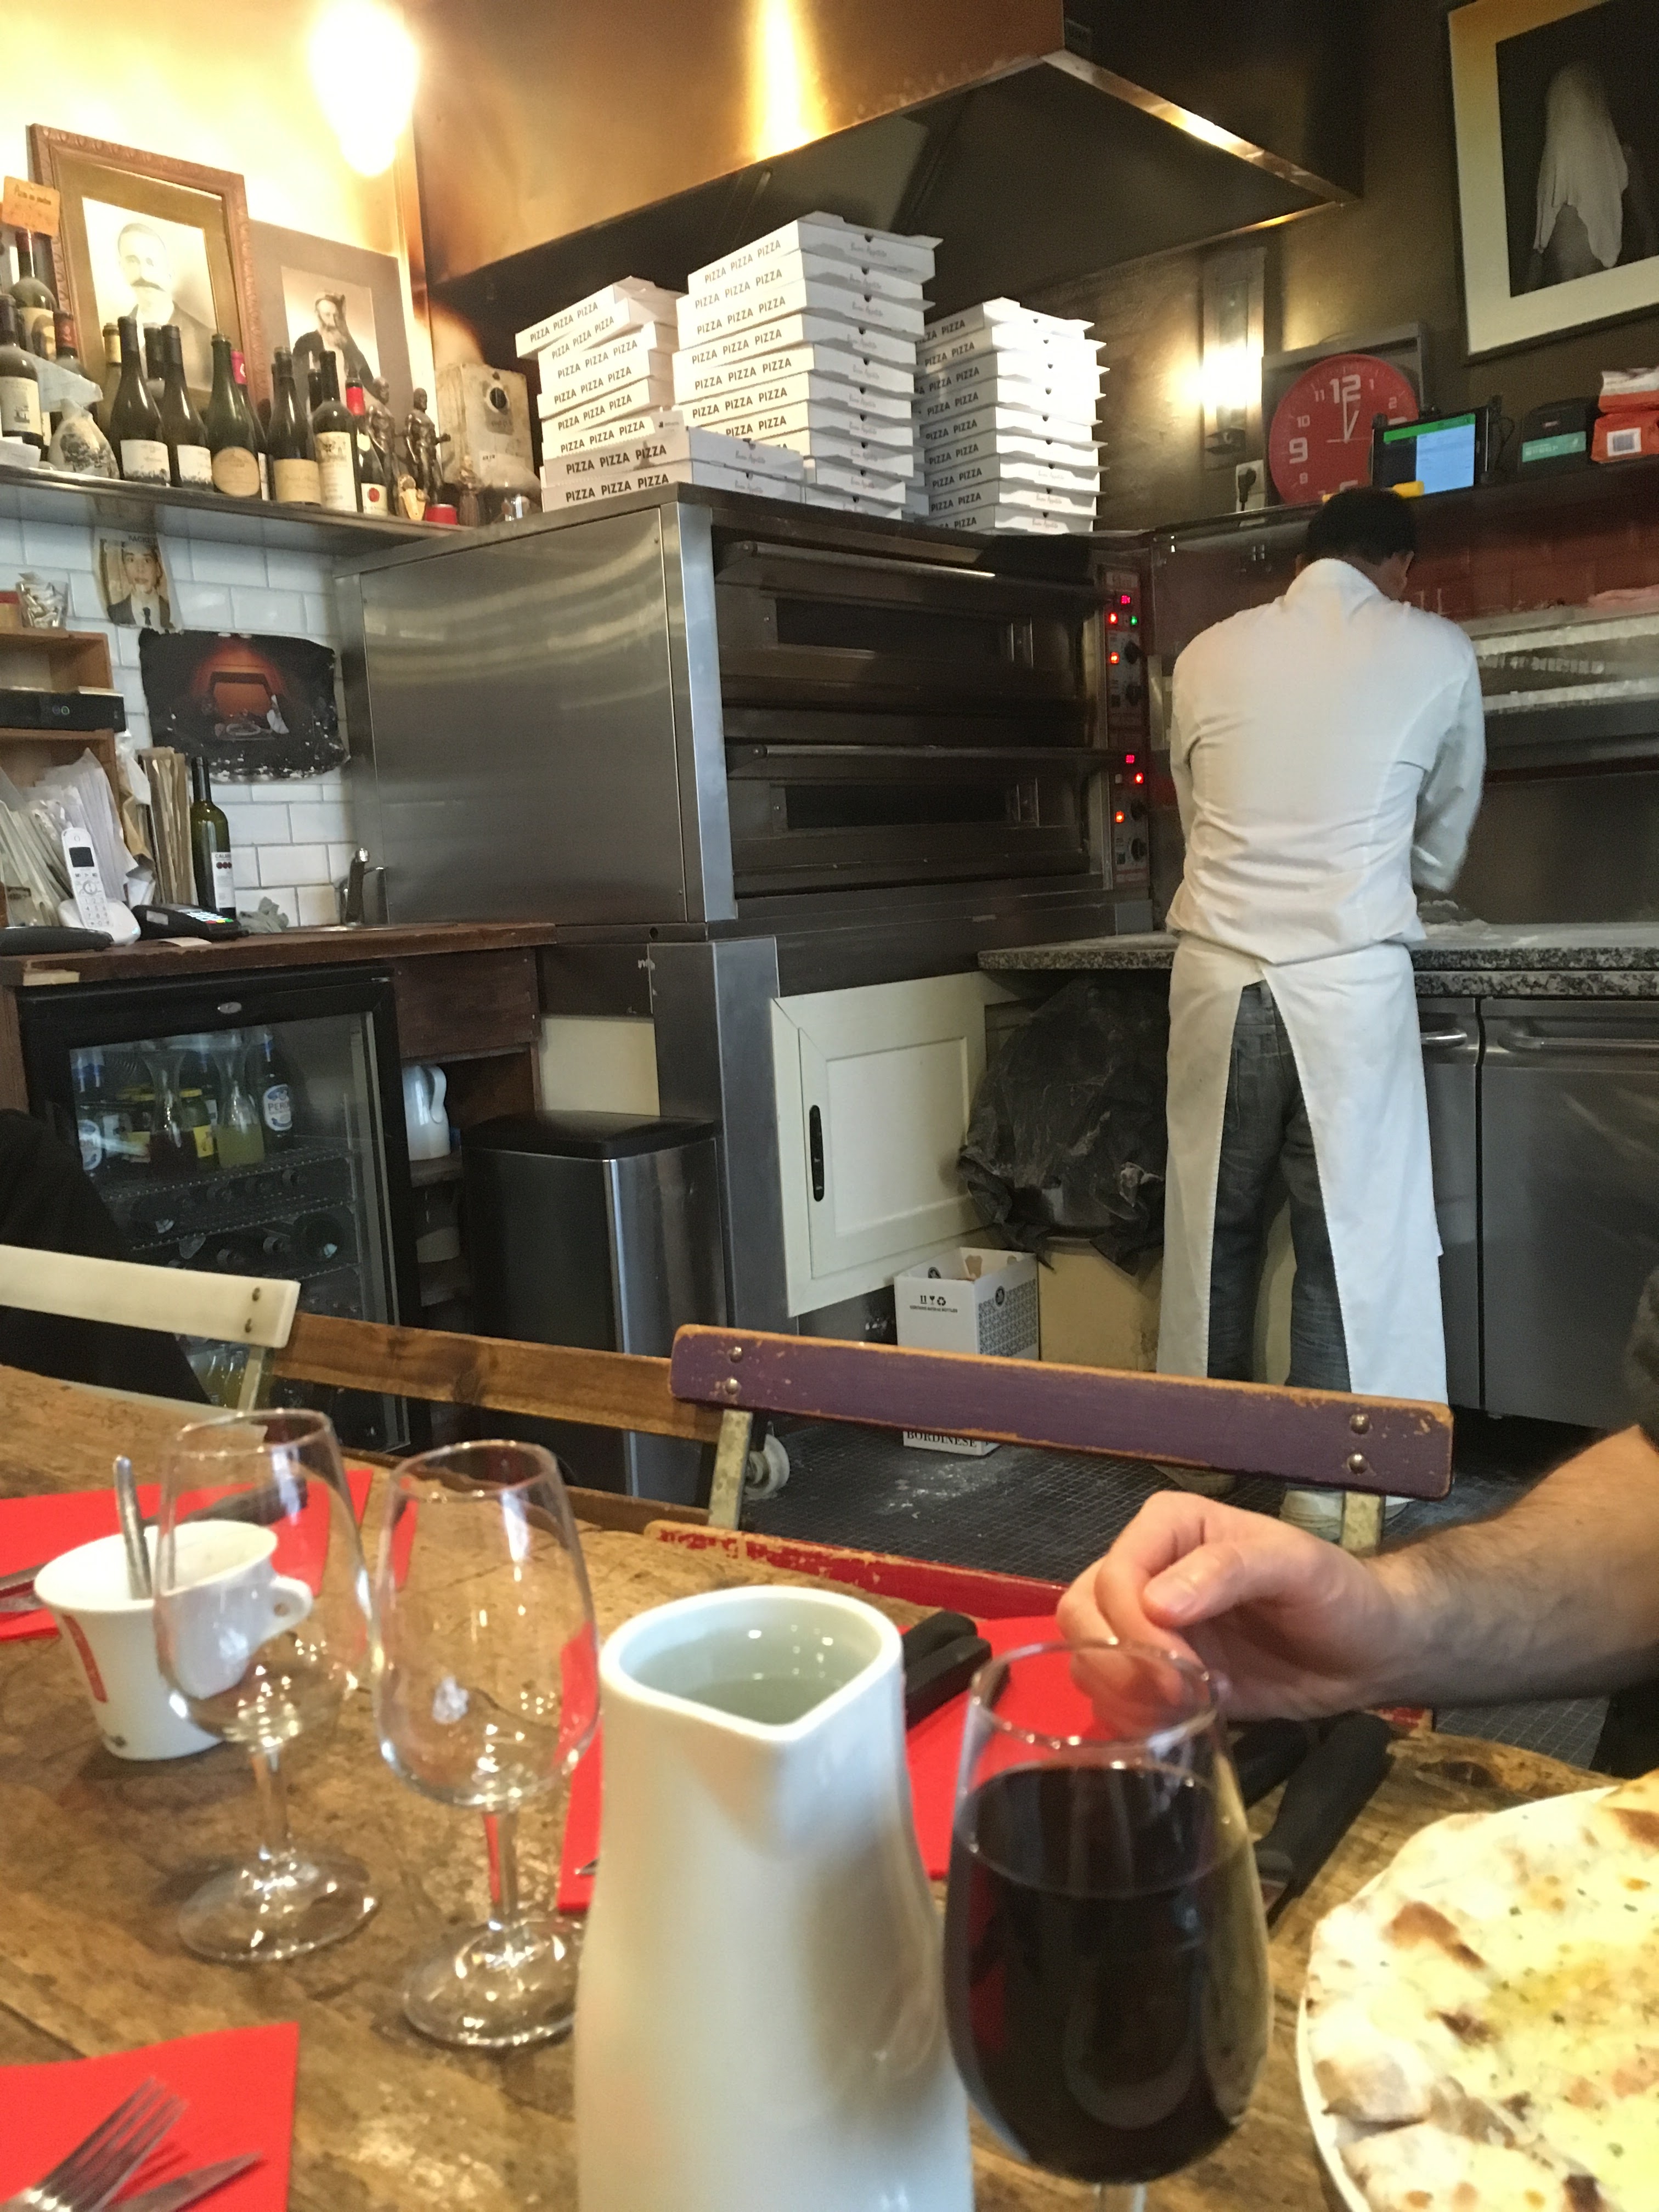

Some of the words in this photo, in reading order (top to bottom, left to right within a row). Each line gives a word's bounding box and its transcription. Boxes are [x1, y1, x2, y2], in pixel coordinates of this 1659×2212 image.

[705, 267, 726, 284] PIZZA
[731, 253, 753, 270] PIZZA
[758, 240, 781, 258] PIZZA
[695, 294, 719, 309] PIZZA
[725, 281, 751, 298] PIZZA
[756, 269, 782, 286] PIZZA
[531, 327, 550, 342] PIZZA
[553, 314, 573, 331] PIZZA
[577, 302, 598, 319] PIZZA
[697, 318, 722, 335] PIZZA
[727, 308, 753, 324] PIZZA
[759, 296, 786, 313] PIZZA
[942, 320, 965, 334] PIZZA
[552, 343, 570, 360] PIZZA
[573, 330, 592, 347] PIZZA
[595, 315, 614, 333] PIZZA
[692, 349, 717, 364] PIZZA
[723, 340, 749, 354] PIZZA
[755, 329, 782, 345] PIZZA
[557, 364, 580, 379] PIZZA
[585, 352, 608, 368] PIZZA
[613, 339, 637, 356] PIZZA
[925, 353, 947, 366] PIZZA
[952, 342, 974, 357] PIZZA
[554, 389, 576, 405] PIZZA
[581, 378, 603, 394] PIZZA
[608, 366, 632, 382] PIZZA
[695, 376, 723, 390] PIZZA
[728, 366, 756, 382] PIZZA
[763, 358, 792, 373] PIZZA
[929, 377, 951, 392] PIZZA
[956, 367, 979, 382] PIZZA
[692, 404, 719, 419] PIZZA
[725, 396, 753, 410] PIZZA
[759, 387, 787, 402] PIZZA
[1314, 390, 1324, 402] 11
[1330, 374, 1361, 404] 12
[1389, 397, 1397, 409] 2
[558, 416, 579, 431] PIZZA
[583, 405, 605, 420] PIZZA
[609, 394, 632, 410] PIZZA
[927, 402, 950, 415] PIZZA
[955, 392, 978, 407] PIZZA
[726, 424, 753, 437] PIZZA
[759, 415, 786, 430] PIZZA
[926, 428, 949, 439] PIZZA
[953, 419, 977, 433] PIZZA
[1297, 415, 1310, 428] 10
[561, 439, 585, 453] PIZZA
[590, 430, 614, 444] PIZZA
[619, 420, 645, 436] PIZZA
[1289, 437, 1308, 464] 9
[566, 460, 594, 474] PIZZA
[600, 452, 630, 466] PIZZA
[636, 444, 667, 459] PIZZA
[929, 453, 951, 465] PIZZA
[956, 444, 979, 457] PIZZA
[566, 488, 595, 503] PIZZA
[601, 480, 631, 495] PIZZA
[637, 473, 669, 489] PIZZA
[933, 477, 955, 489] PIZZA
[959, 468, 982, 481] PIZZA
[1300, 472, 1308, 484] 8
[931, 500, 953, 512] PIZZA
[958, 493, 981, 505] PIZZA
[955, 517, 977, 528] PIZZA
